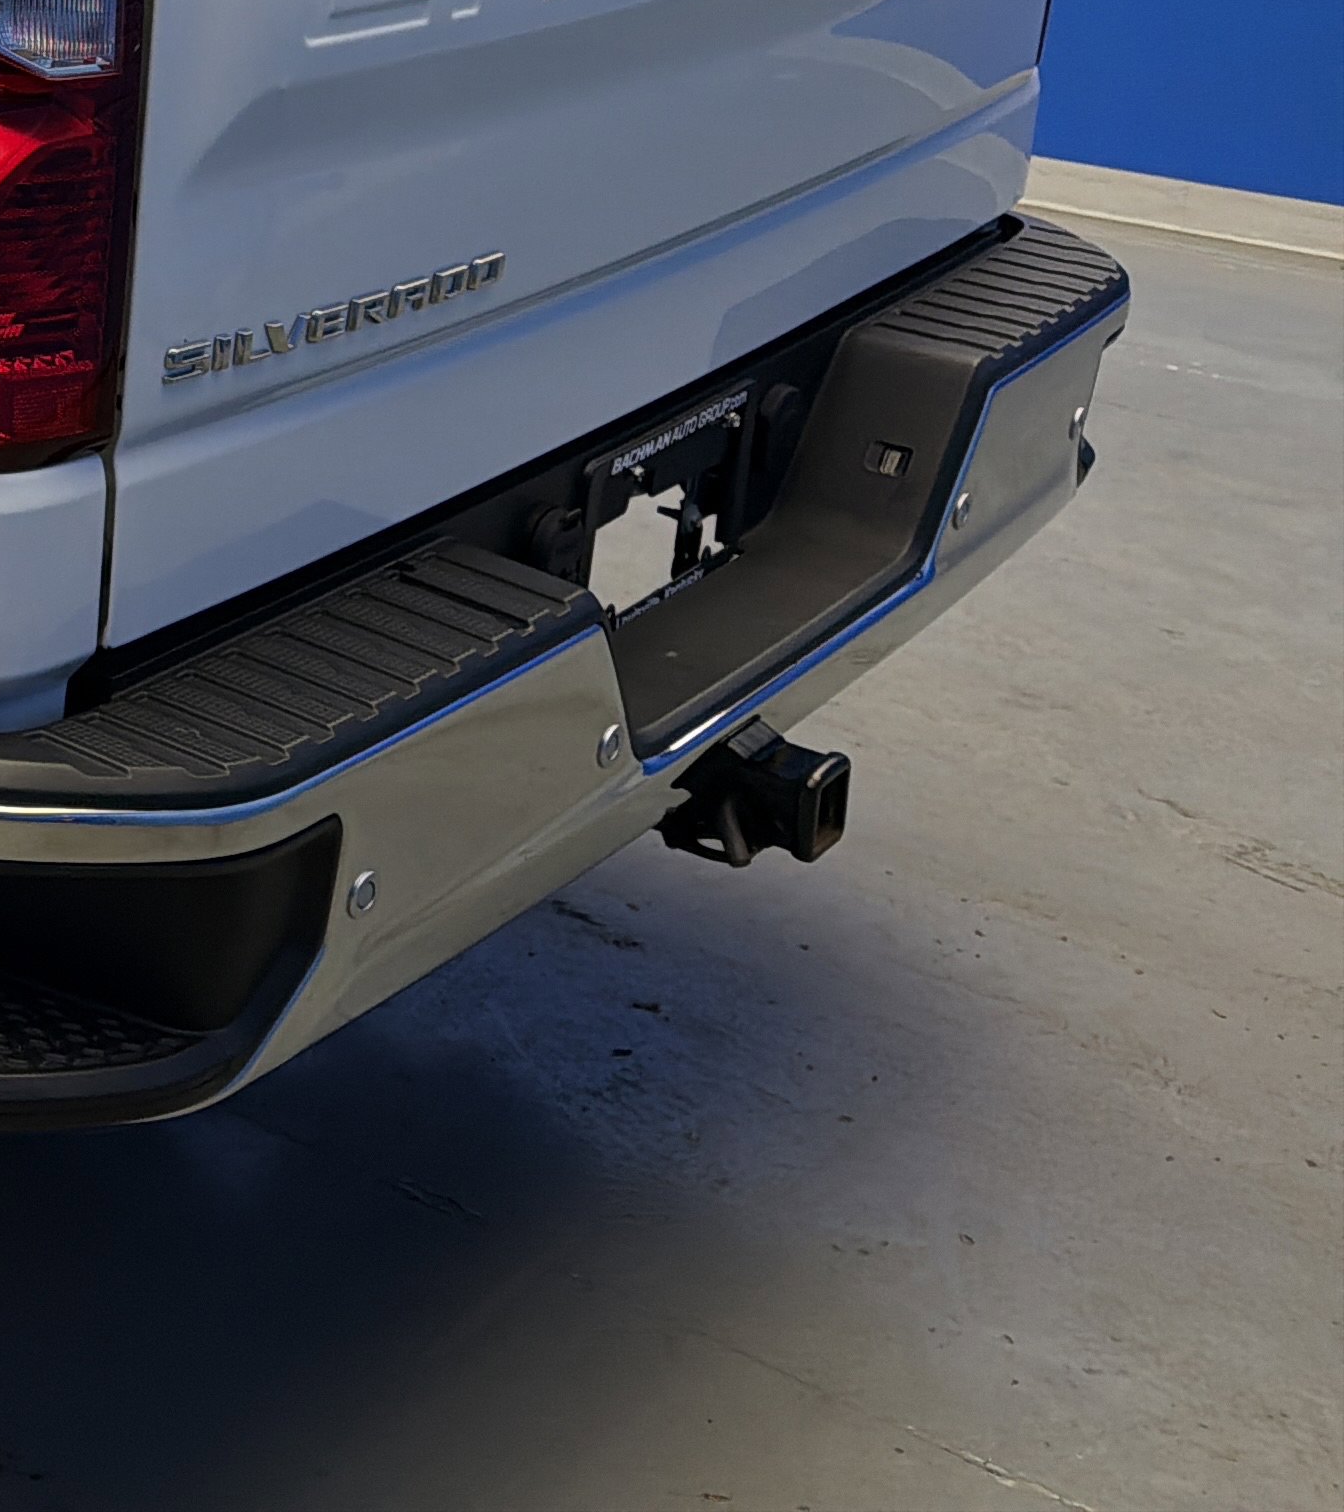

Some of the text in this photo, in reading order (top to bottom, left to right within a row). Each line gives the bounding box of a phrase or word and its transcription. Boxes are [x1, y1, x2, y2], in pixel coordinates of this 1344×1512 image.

[162, 250, 506, 385] SILVERADO
[611, 430, 673, 476] BACHMAN
[672, 416, 698, 442] AUTO
